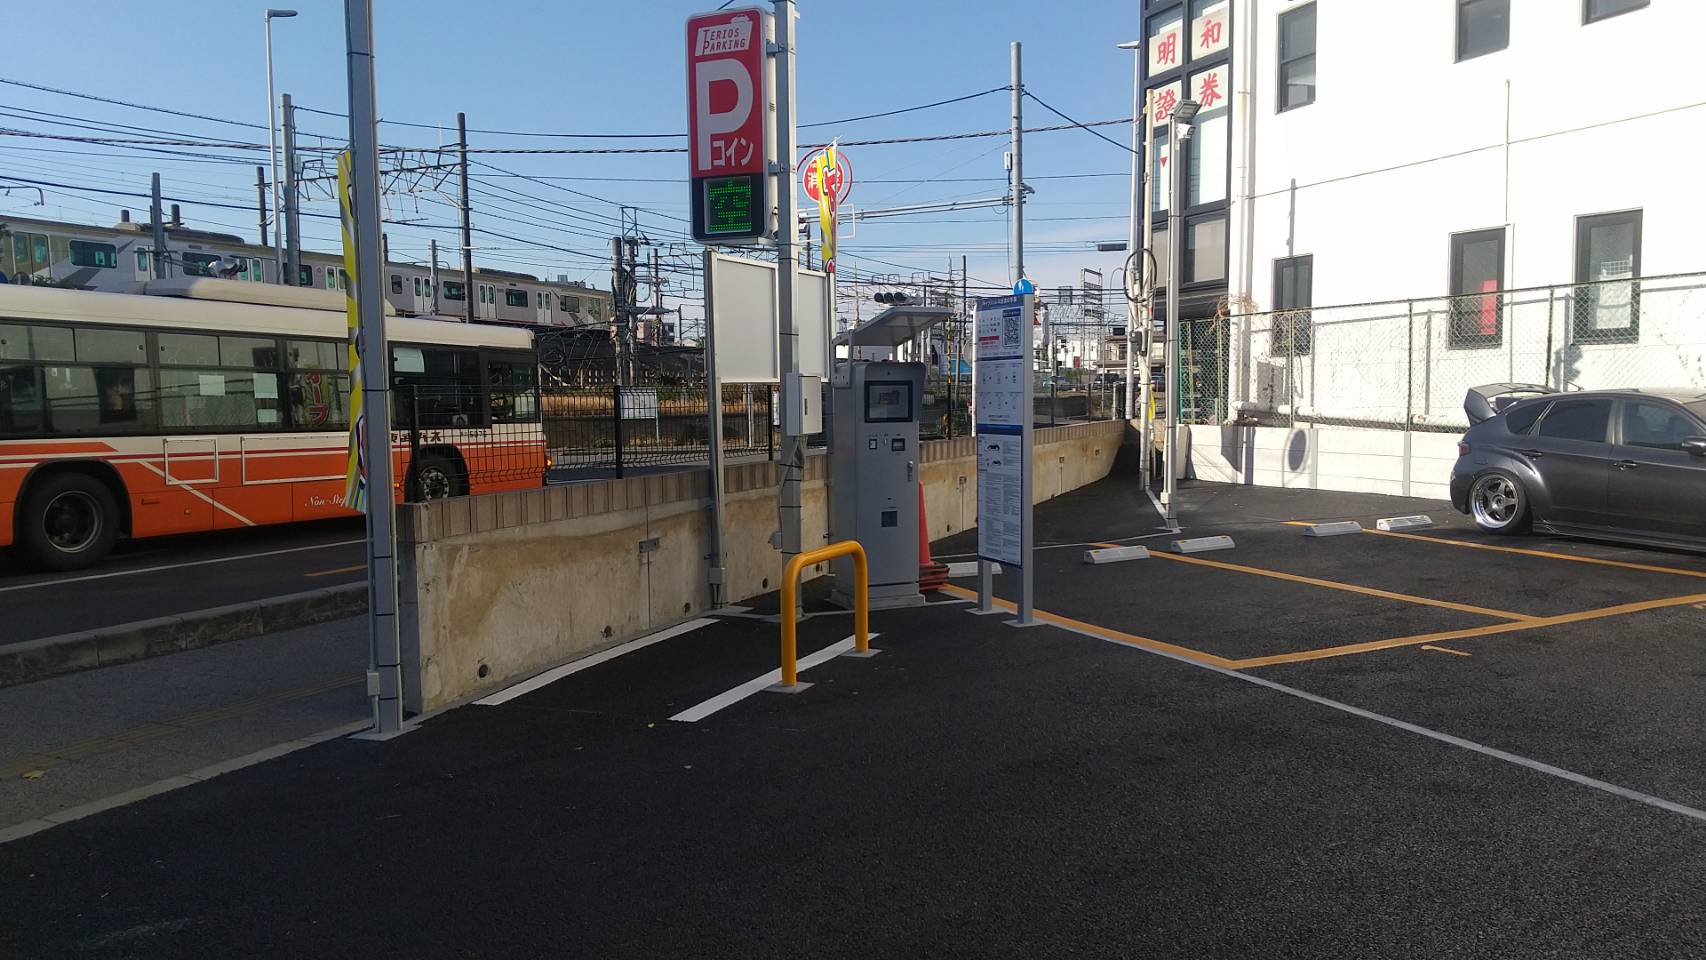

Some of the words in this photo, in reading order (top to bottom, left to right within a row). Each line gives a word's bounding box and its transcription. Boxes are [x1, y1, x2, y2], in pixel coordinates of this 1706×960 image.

[702, 38, 746, 54] PARKING
[703, 28, 740, 42] TERIOS
[695, 58, 753, 170] P
[712, 137, 754, 167] コイン
